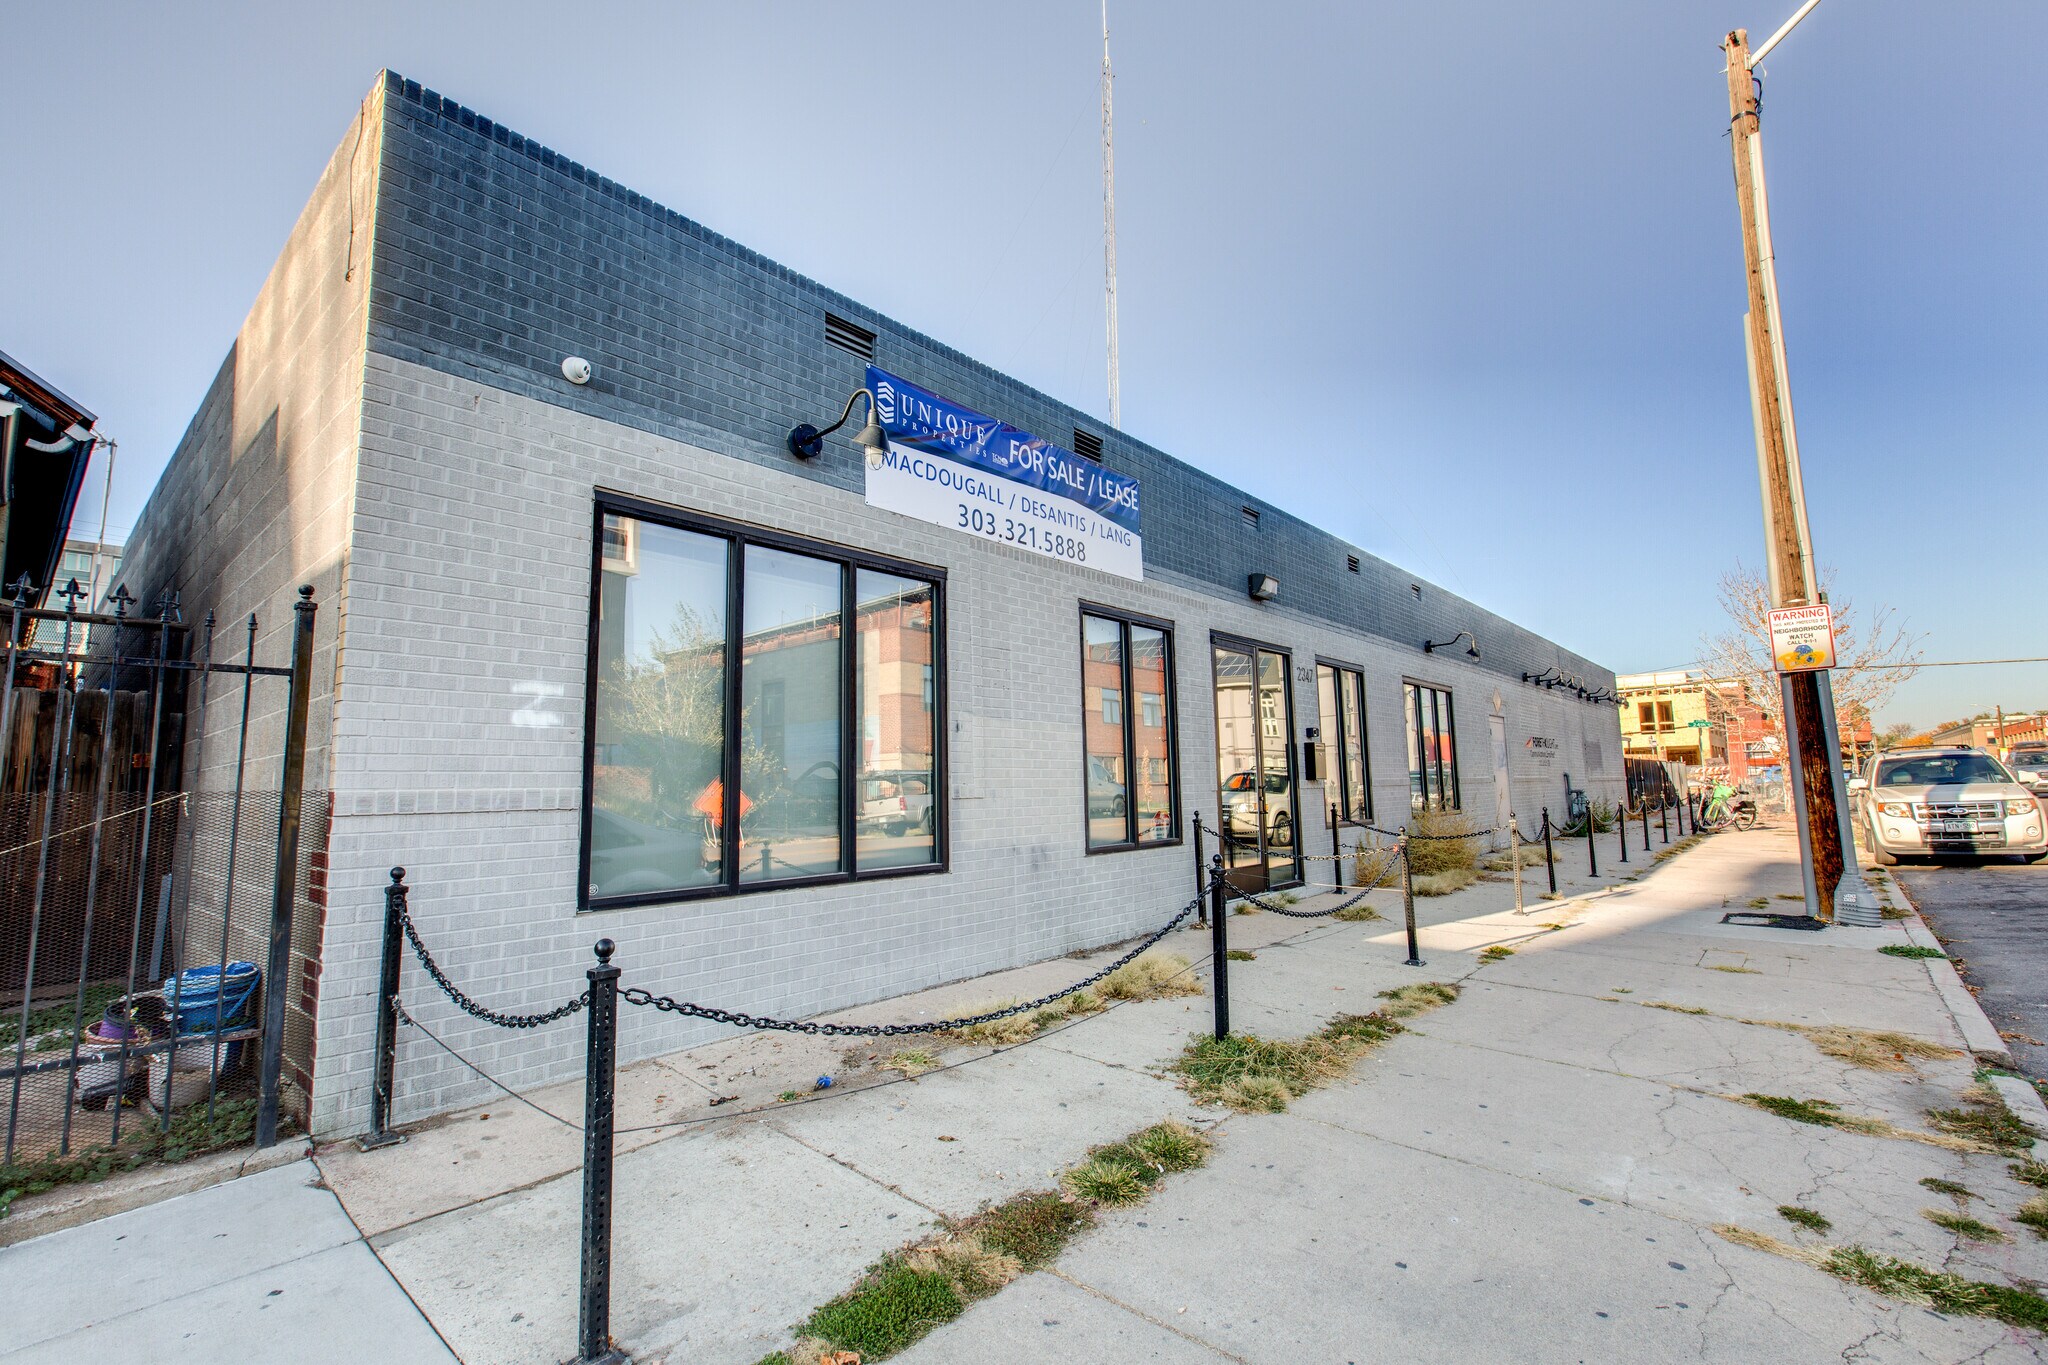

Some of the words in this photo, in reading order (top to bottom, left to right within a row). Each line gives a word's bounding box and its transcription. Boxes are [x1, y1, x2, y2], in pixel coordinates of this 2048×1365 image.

[901, 394, 986, 446] UNIQUE
[902, 418, 987, 458] PROPERTIES
[1009, 439, 1045, 475] FOR
[1048, 457, 1085, 491] SALE
[1088, 473, 1095, 496] /
[1099, 476, 1139, 511] LEASE
[884, 450, 1004, 505] MACDOUGALL
[1009, 493, 1016, 510] /
[1021, 497, 1086, 532] DESANTIS
[1100, 524, 1131, 547] LANG
[958, 504, 1086, 562] 303.321.5888
[1773, 609, 1824, 621] WARNING
[1774, 625, 1828, 634] NEIGHBORHOOD
[1296, 667, 1313, 683] 2347
